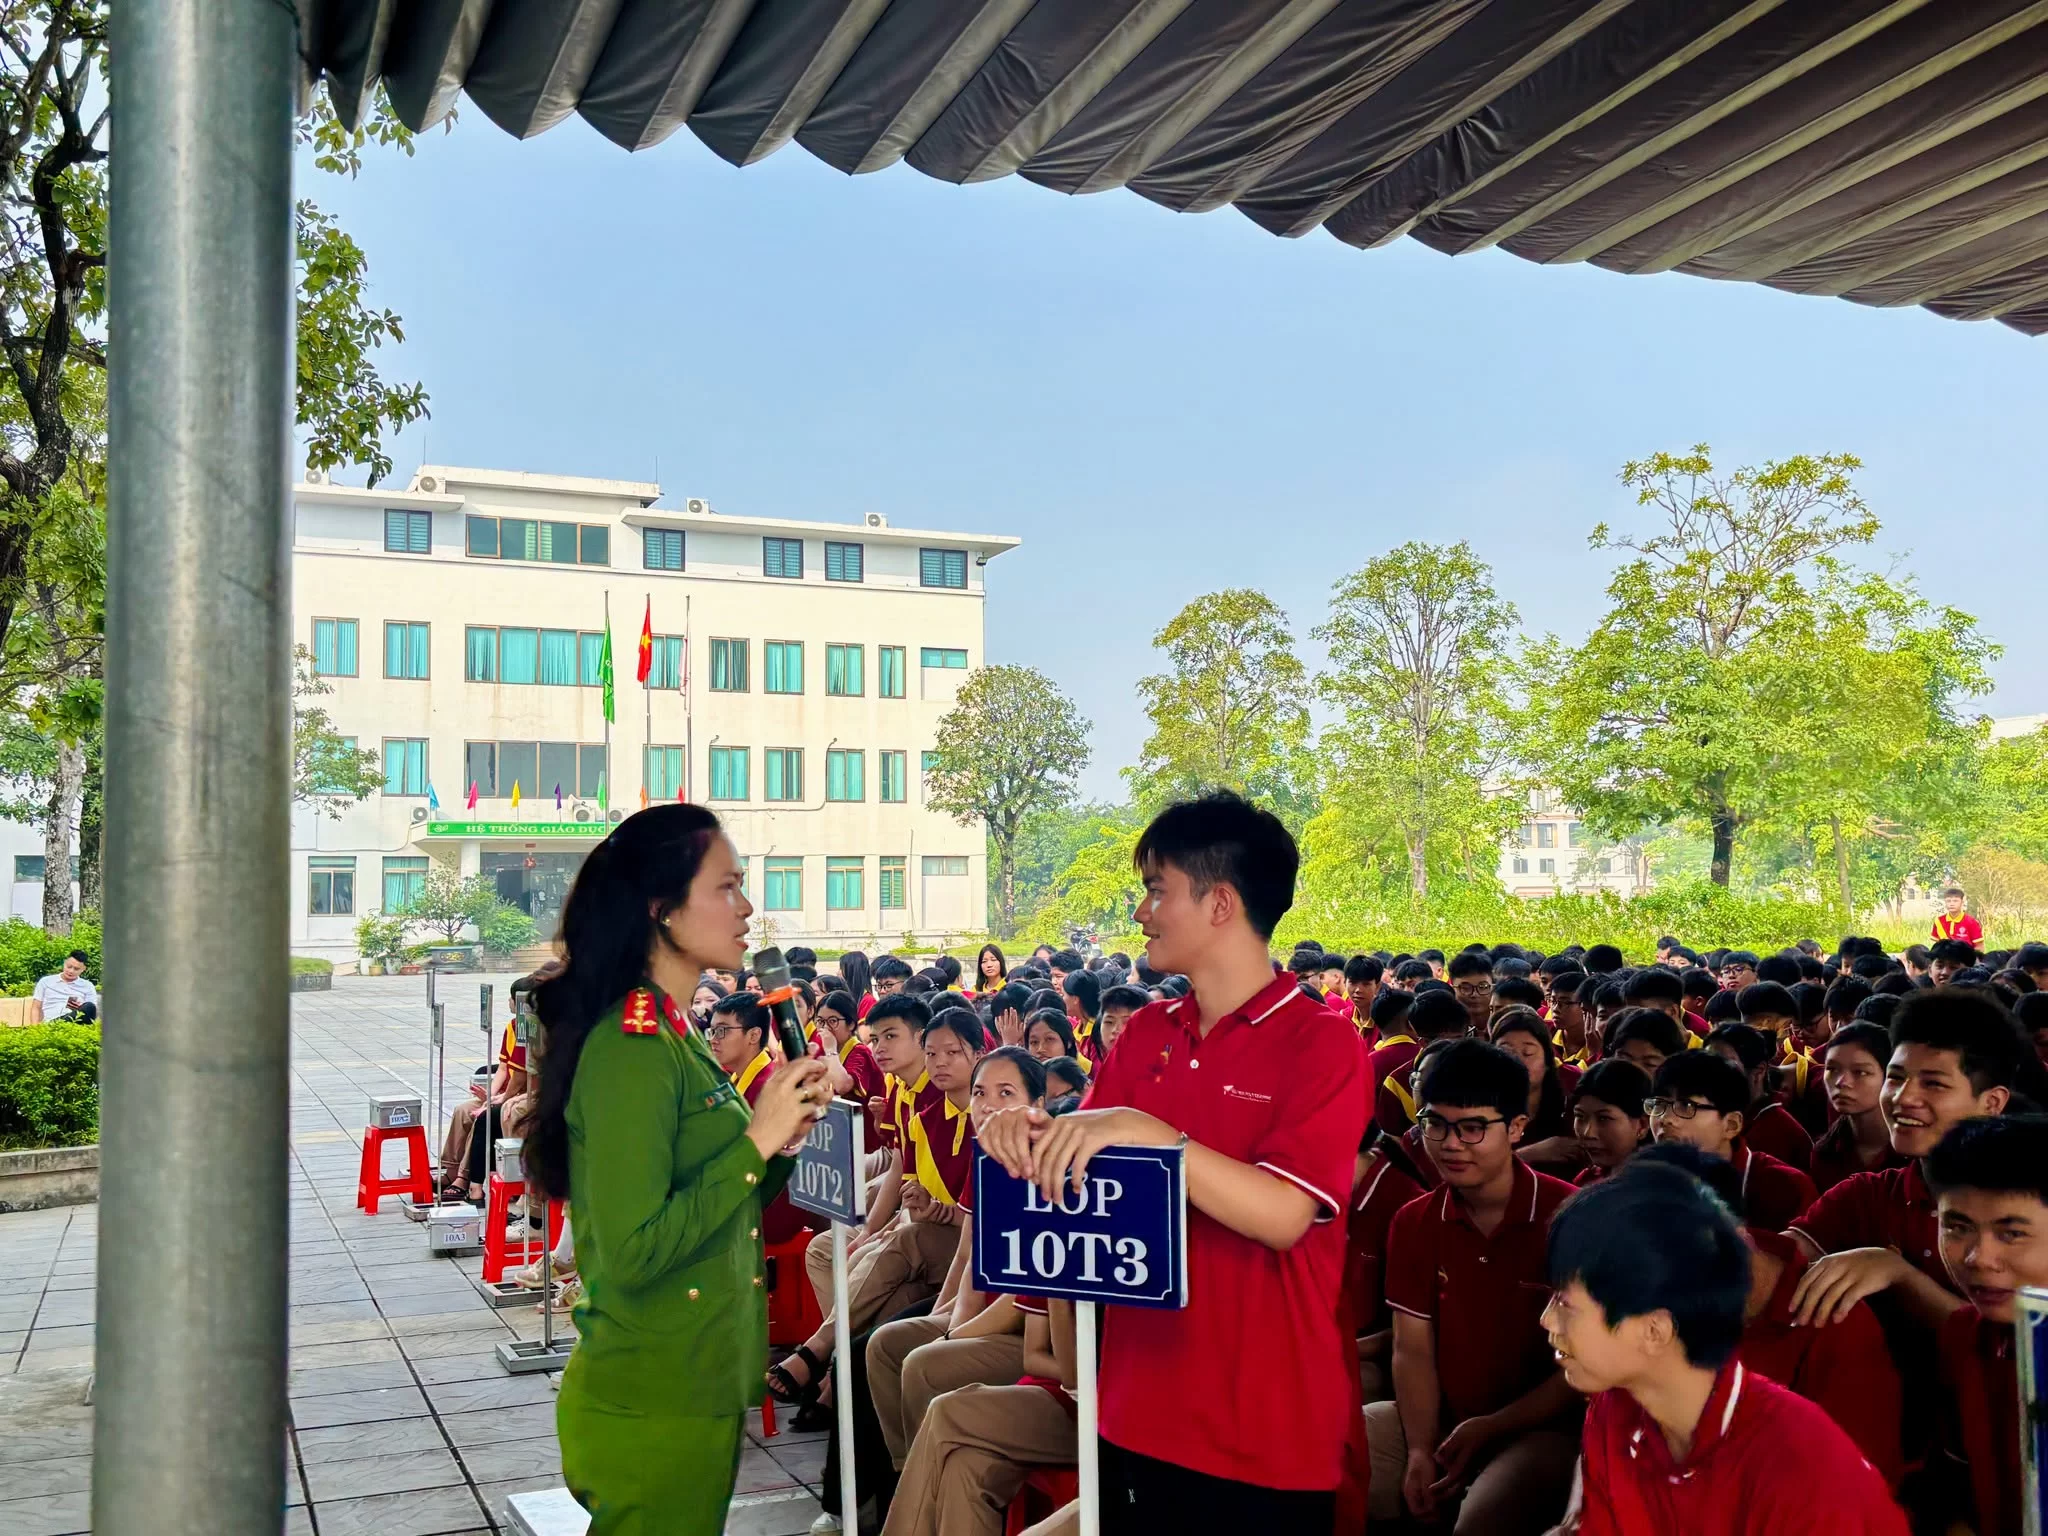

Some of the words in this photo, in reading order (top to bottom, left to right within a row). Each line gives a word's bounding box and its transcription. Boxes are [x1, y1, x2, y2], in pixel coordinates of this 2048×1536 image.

[466, 824, 486, 834] HỆ
[489, 822, 538, 833] THỐNG
[541, 823, 575, 833] GIÁO
[796, 1159, 844, 1207] 10T2
[445, 1233, 466, 1242] 10A3
[1001, 1228, 1149, 1286] 10T3
